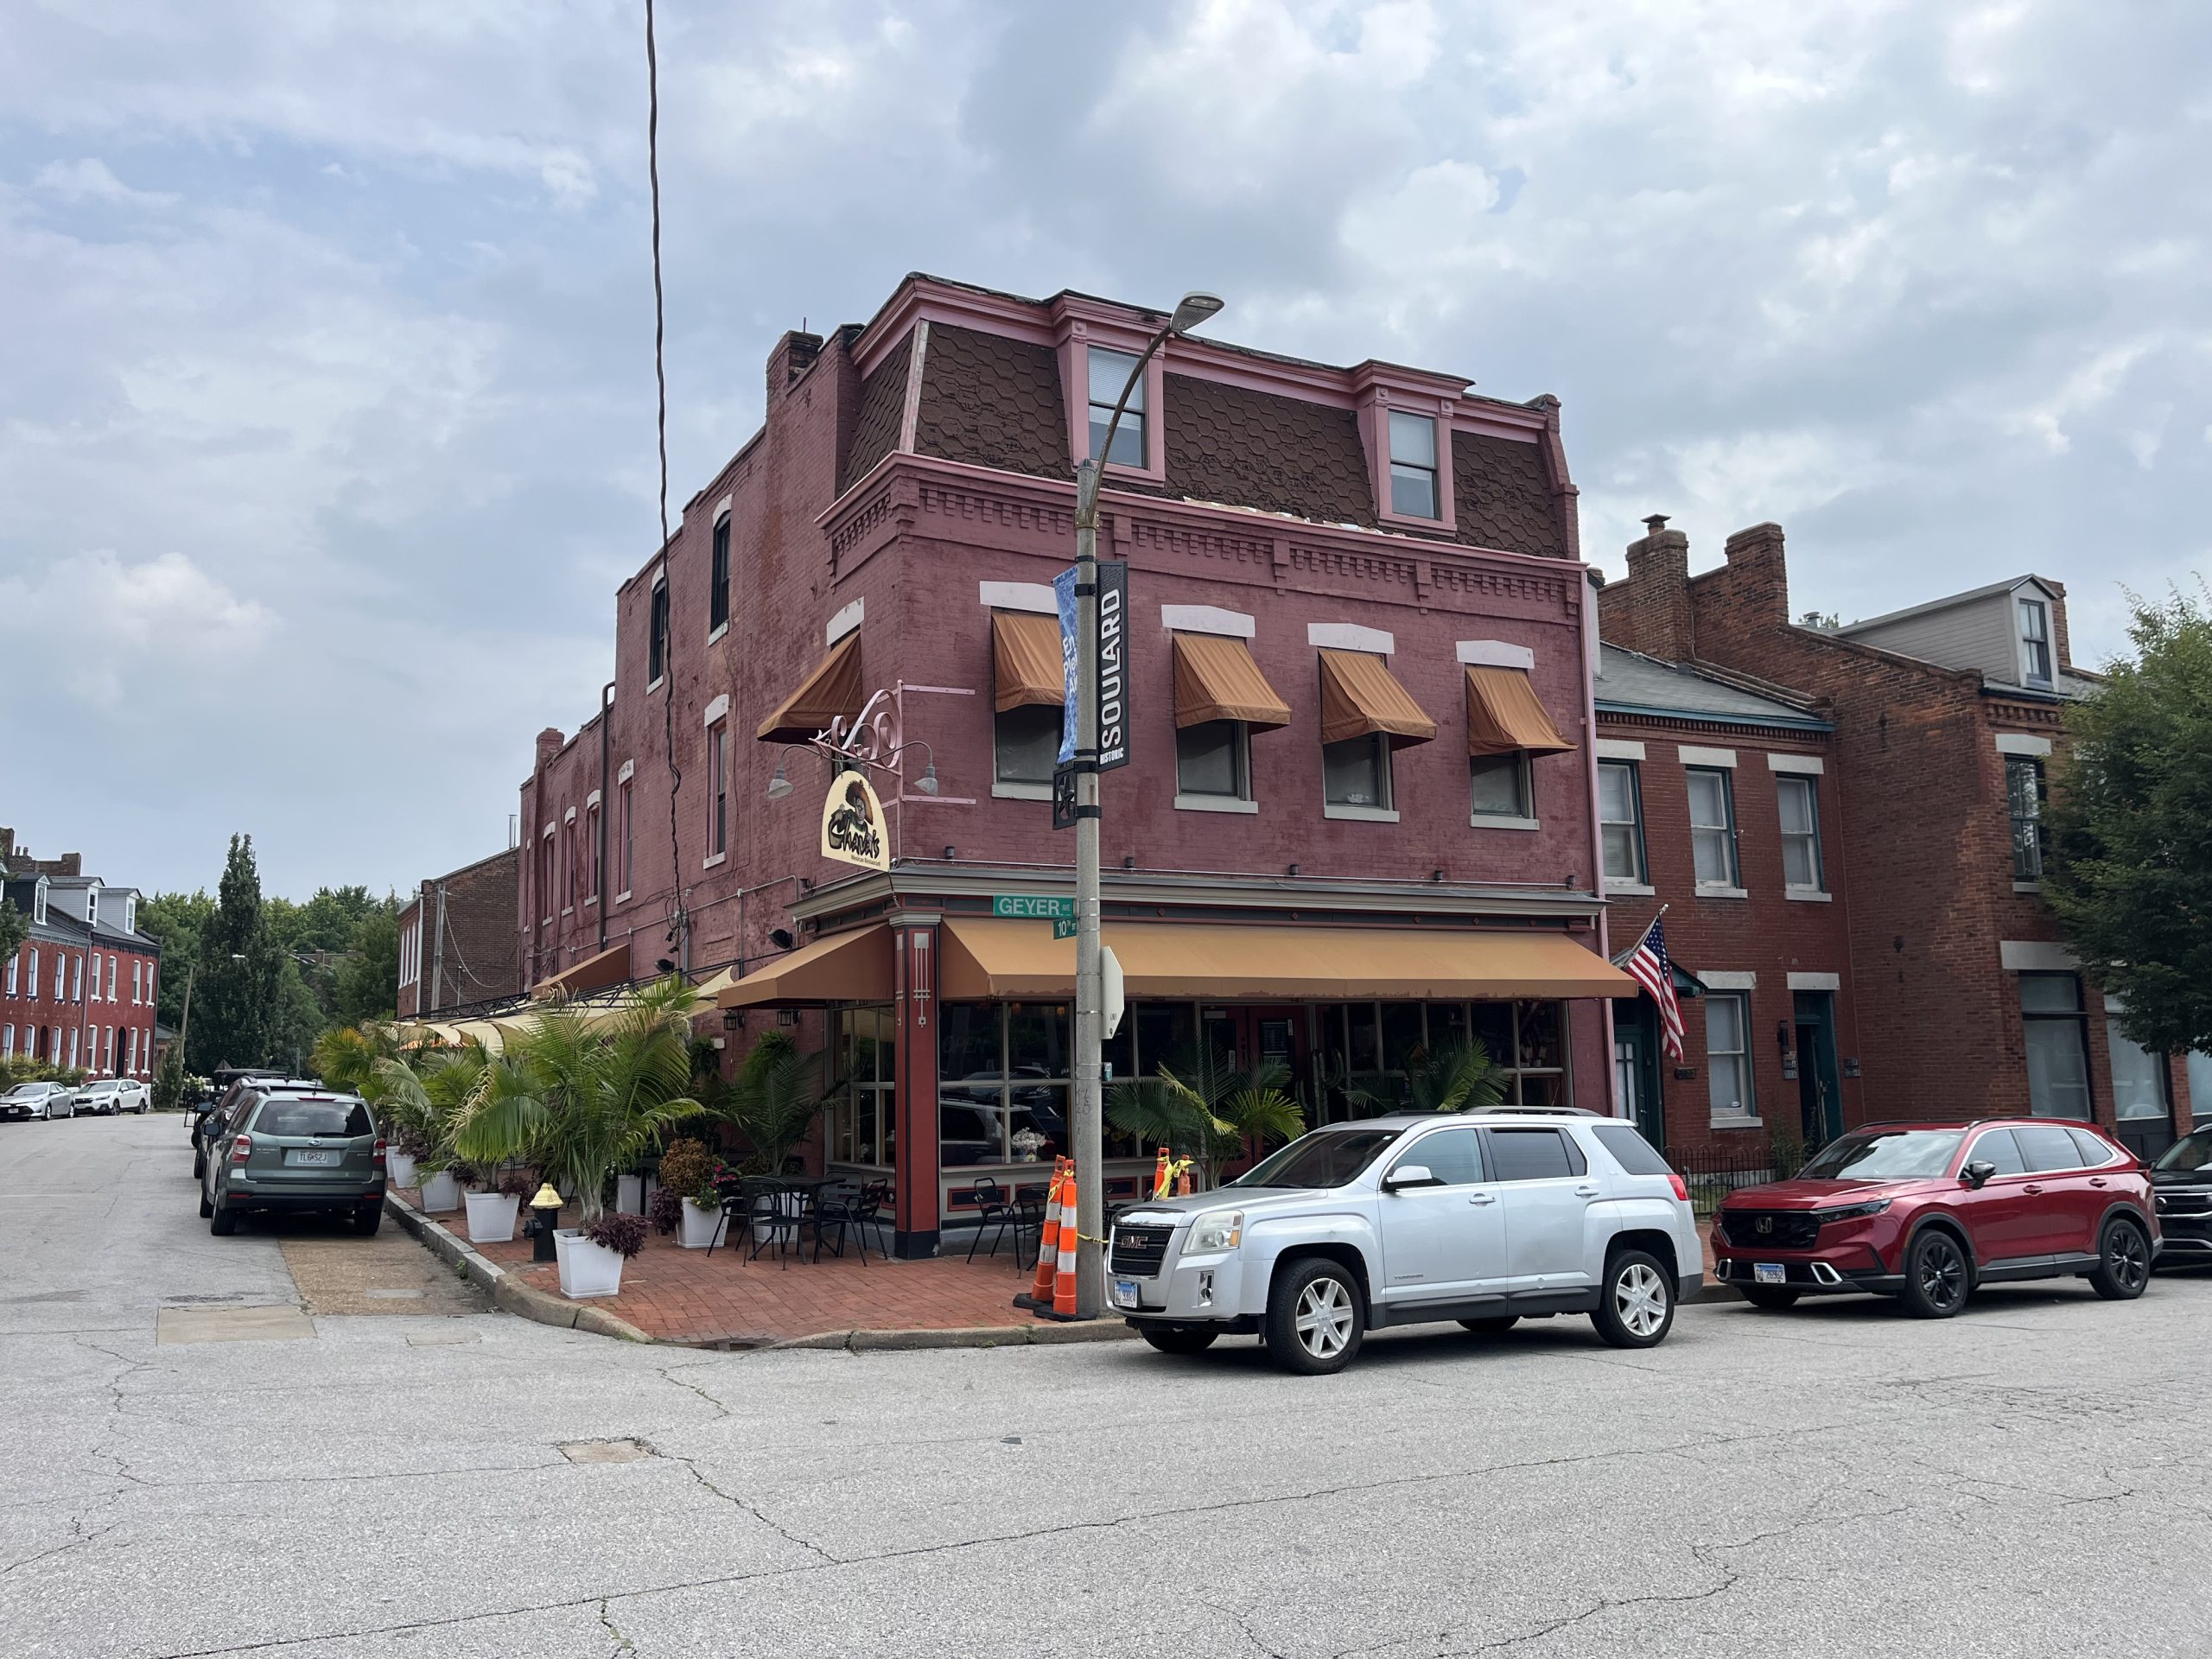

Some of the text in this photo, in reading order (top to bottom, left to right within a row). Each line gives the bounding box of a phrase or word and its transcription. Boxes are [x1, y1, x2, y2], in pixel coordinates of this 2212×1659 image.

[1063, 635, 1075, 658] En
[1101, 588, 1122, 750] SOULARD
[1099, 747, 1124, 766] HISTORIC
[828, 817, 880, 859] Chava's
[999, 898, 1059, 915] GEYER
[1058, 919, 1071, 936] 10TH
[943, 1035, 986, 1053] OPEN
[1120, 1236, 1148, 1249] GMC
